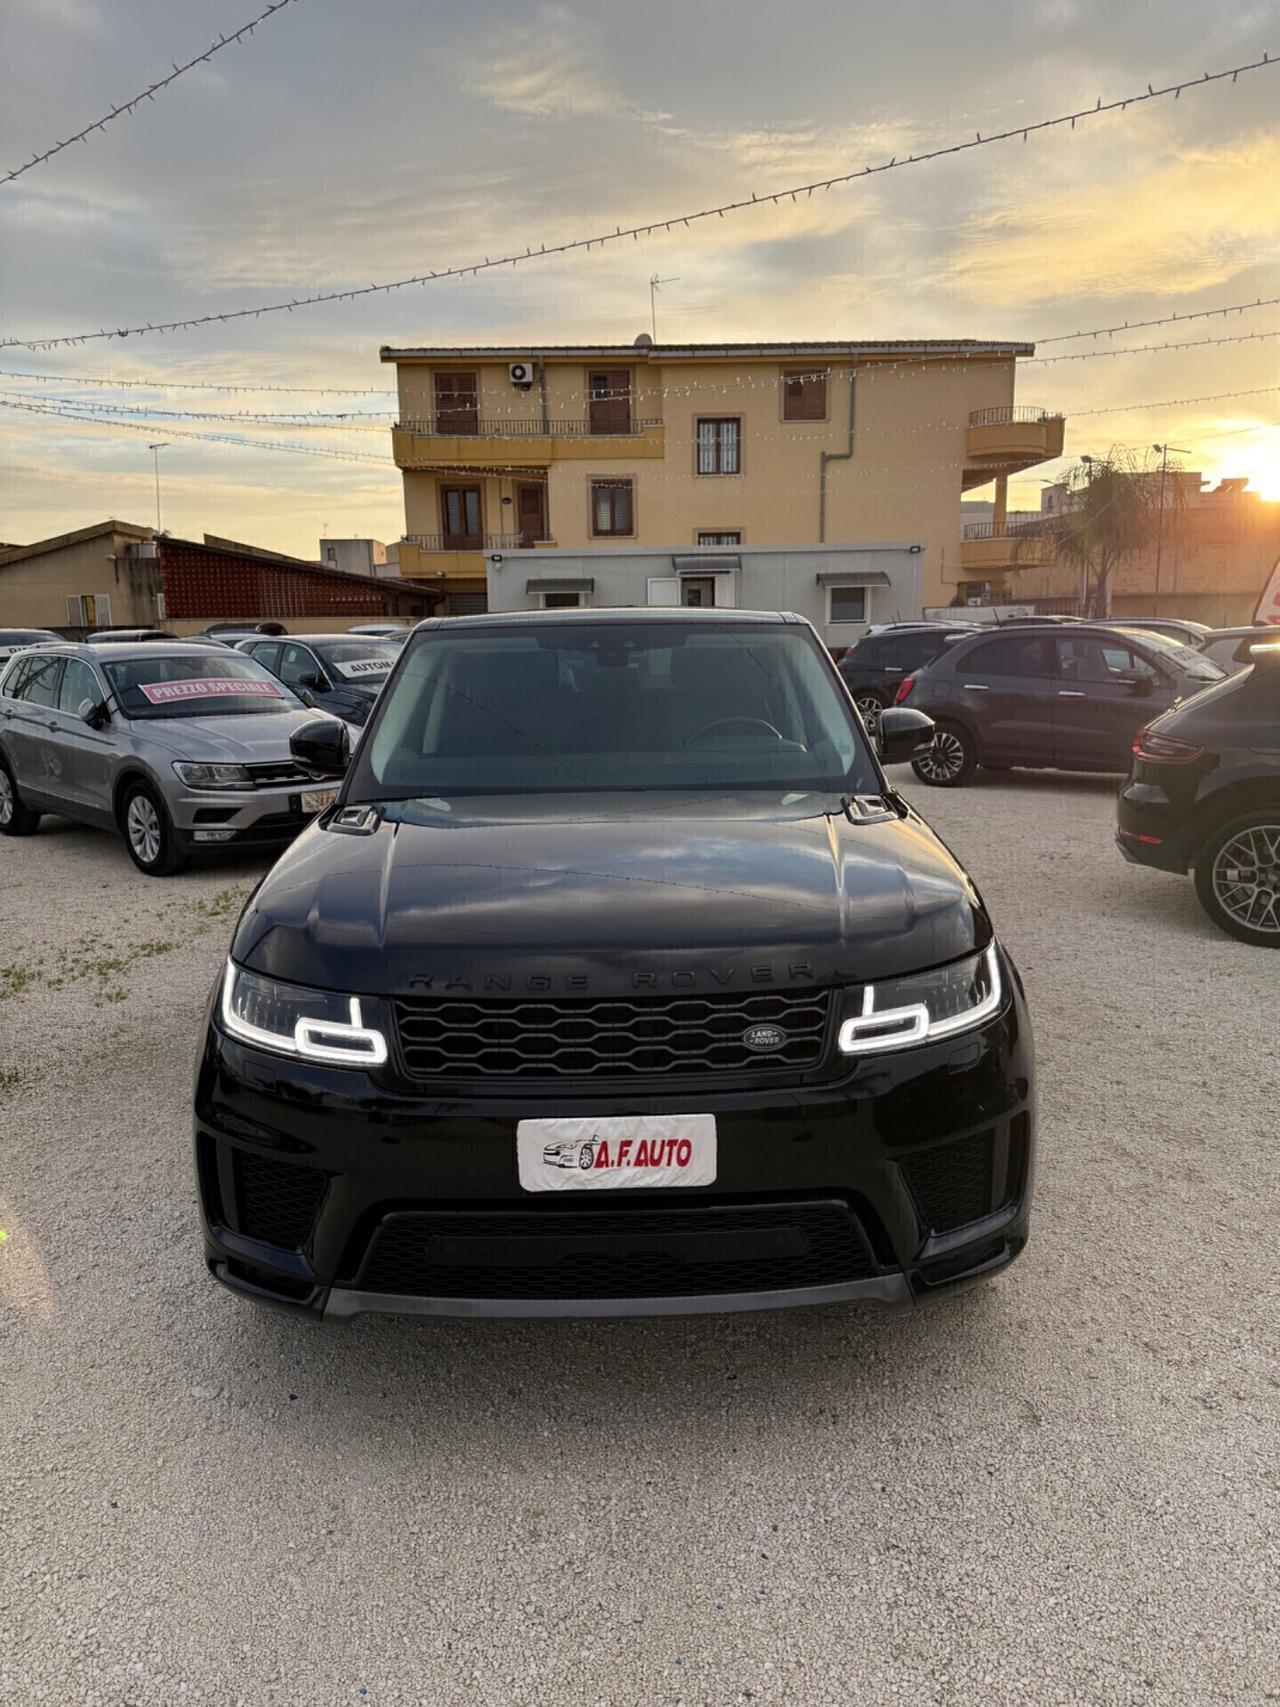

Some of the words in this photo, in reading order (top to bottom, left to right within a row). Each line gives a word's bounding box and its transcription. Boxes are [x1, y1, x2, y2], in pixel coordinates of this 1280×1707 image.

[152, 684, 207, 698] PREZZO
[208, 681, 274, 694] SPECIALE
[408, 973, 590, 991] RANGE
[632, 962, 815, 989] ROVER
[751, 1030, 773, 1038] LAND
